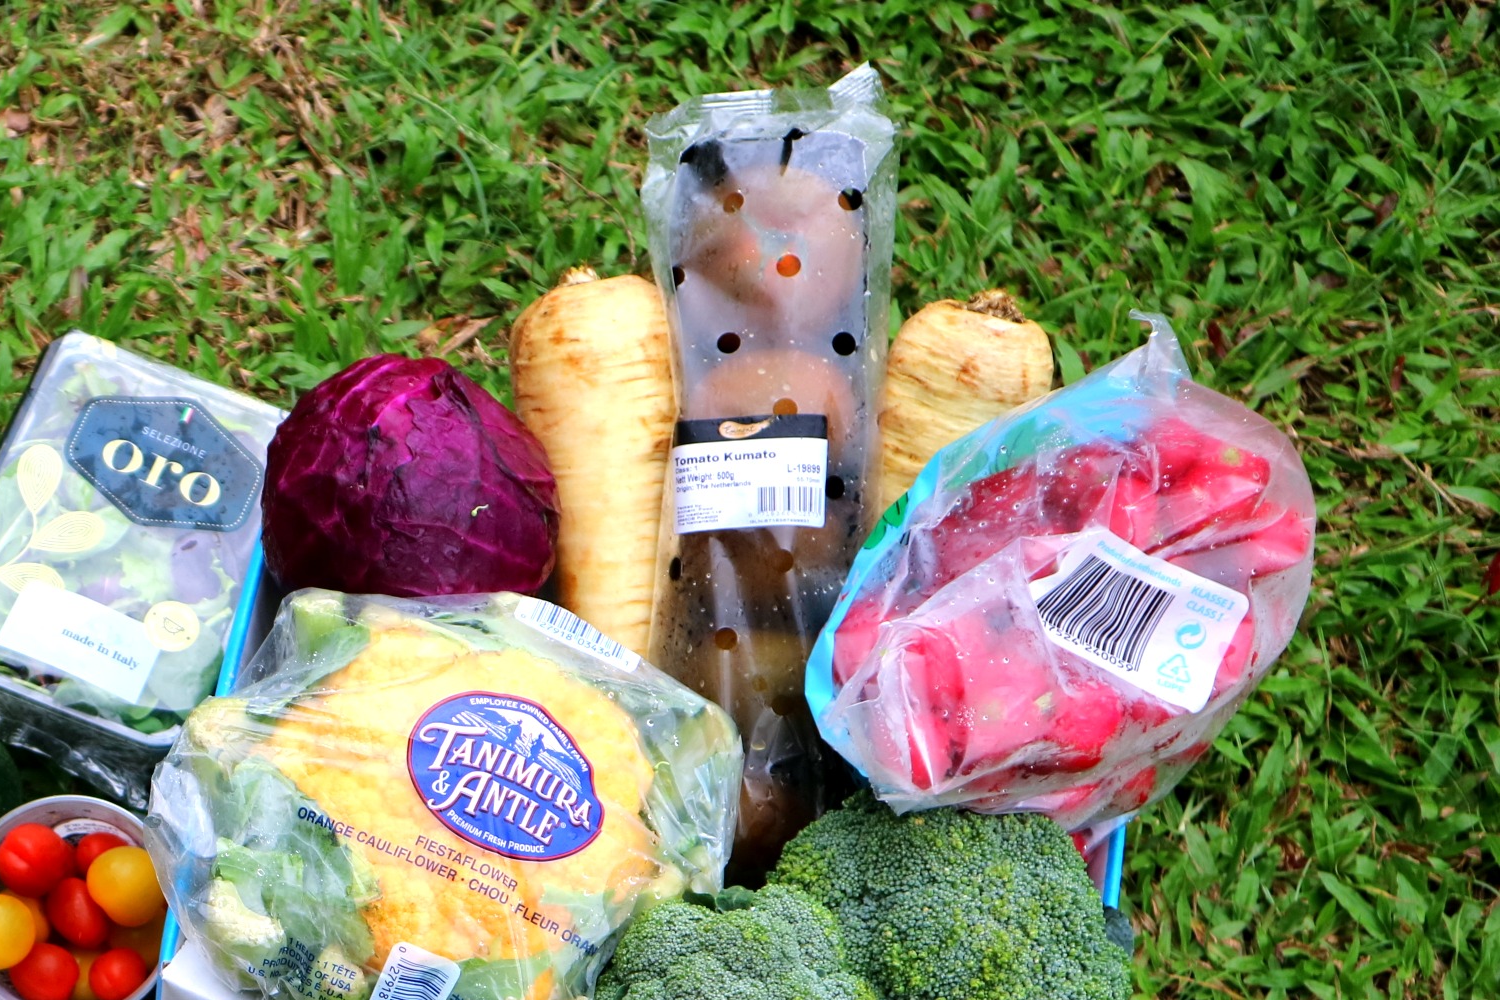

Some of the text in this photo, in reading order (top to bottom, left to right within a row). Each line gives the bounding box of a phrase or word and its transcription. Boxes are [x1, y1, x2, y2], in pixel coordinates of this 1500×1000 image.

[141, 426, 207, 459] SELEZIONE
[675, 450, 777, 467] Tomato Kumato
[102, 439, 221, 507] oro
[711, 480, 751, 489] Netherlands
[787, 464, 821, 474] L-19899
[1186, 600, 1218, 621] CLASS
[1190, 586, 1229, 610] KLASSE
[61, 625, 140, 670] made in Italy
[539, 620, 611, 658] 27918 03436
[470, 698, 590, 774] EMPLOYEE OWNED FAMILY FARM
[419, 721, 593, 833] TANIMURA
[426, 770, 561, 847] & ANTLE
[297, 806, 354, 839] ORANGE
[356, 830, 457, 882] CAULIFLOWER
[446, 808, 545, 854] PREMIUM FRESH PRODUCE
[414, 834, 519, 893] FIESTAFLOWER
[294, 938, 316, 962] HEAD
[331, 961, 357, 980] TÊTE
[314, 970, 329, 982] OF
[330, 975, 352, 993] USA
[378, 964, 400, 1000] 27918
